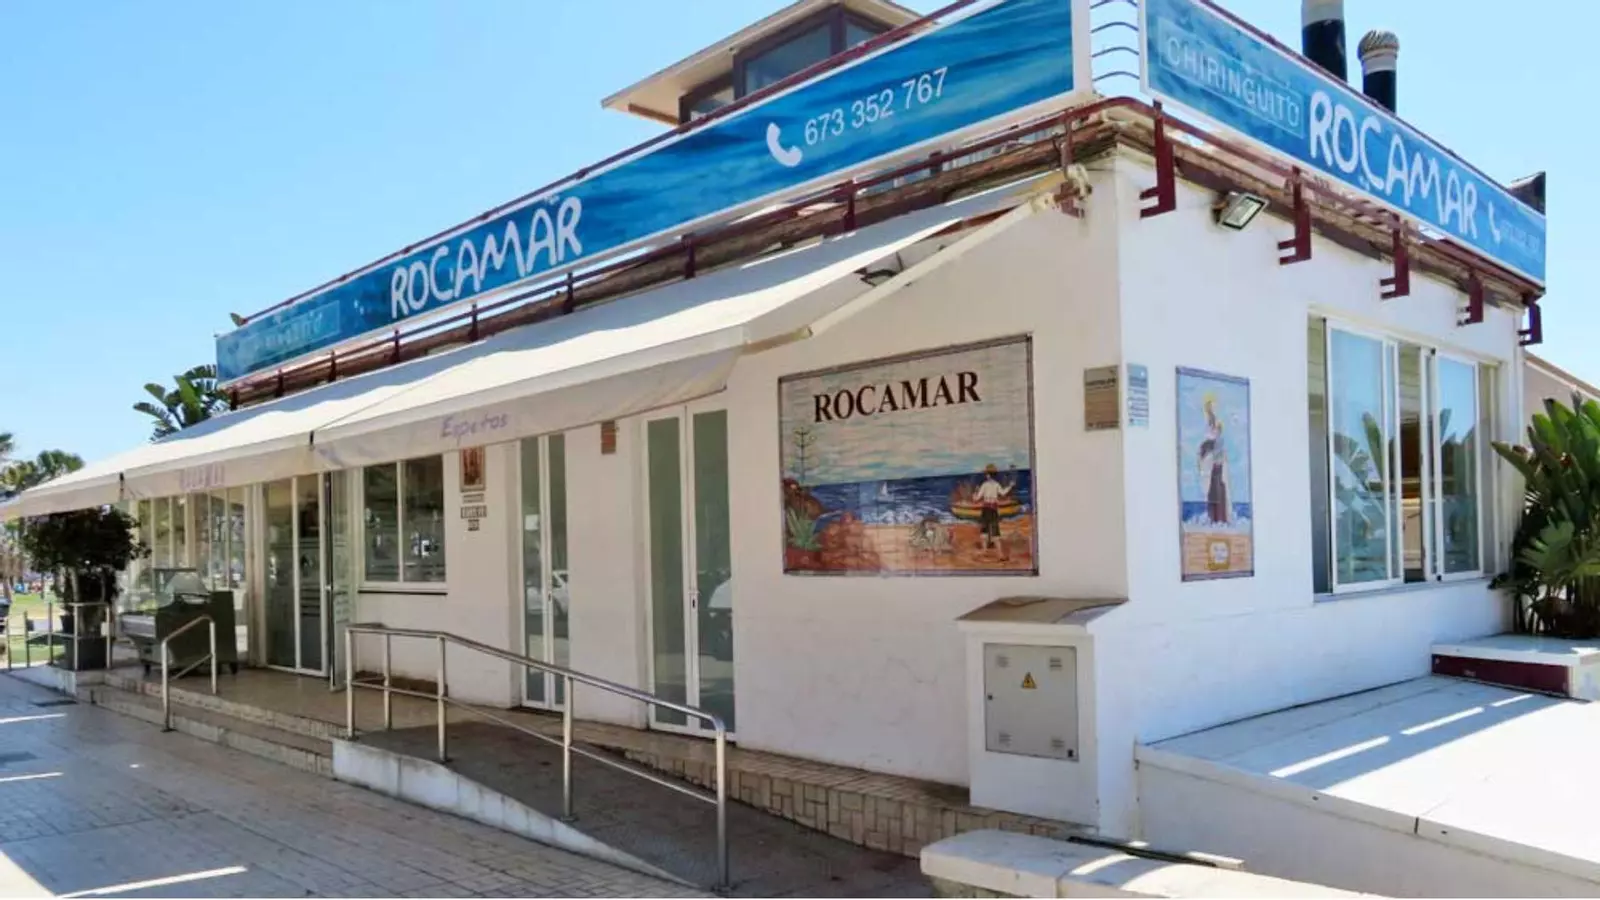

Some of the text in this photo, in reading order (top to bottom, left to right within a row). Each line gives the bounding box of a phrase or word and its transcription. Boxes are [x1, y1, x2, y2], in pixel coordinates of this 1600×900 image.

[804, 66, 948, 145] 673 352 767
[1165, 35, 1300, 127] CHIRINGUITO
[1309, 89, 1478, 240] ROCAMAR
[390, 196, 583, 319] ROCAMAR
[813, 371, 981, 423] ROCAMAR
